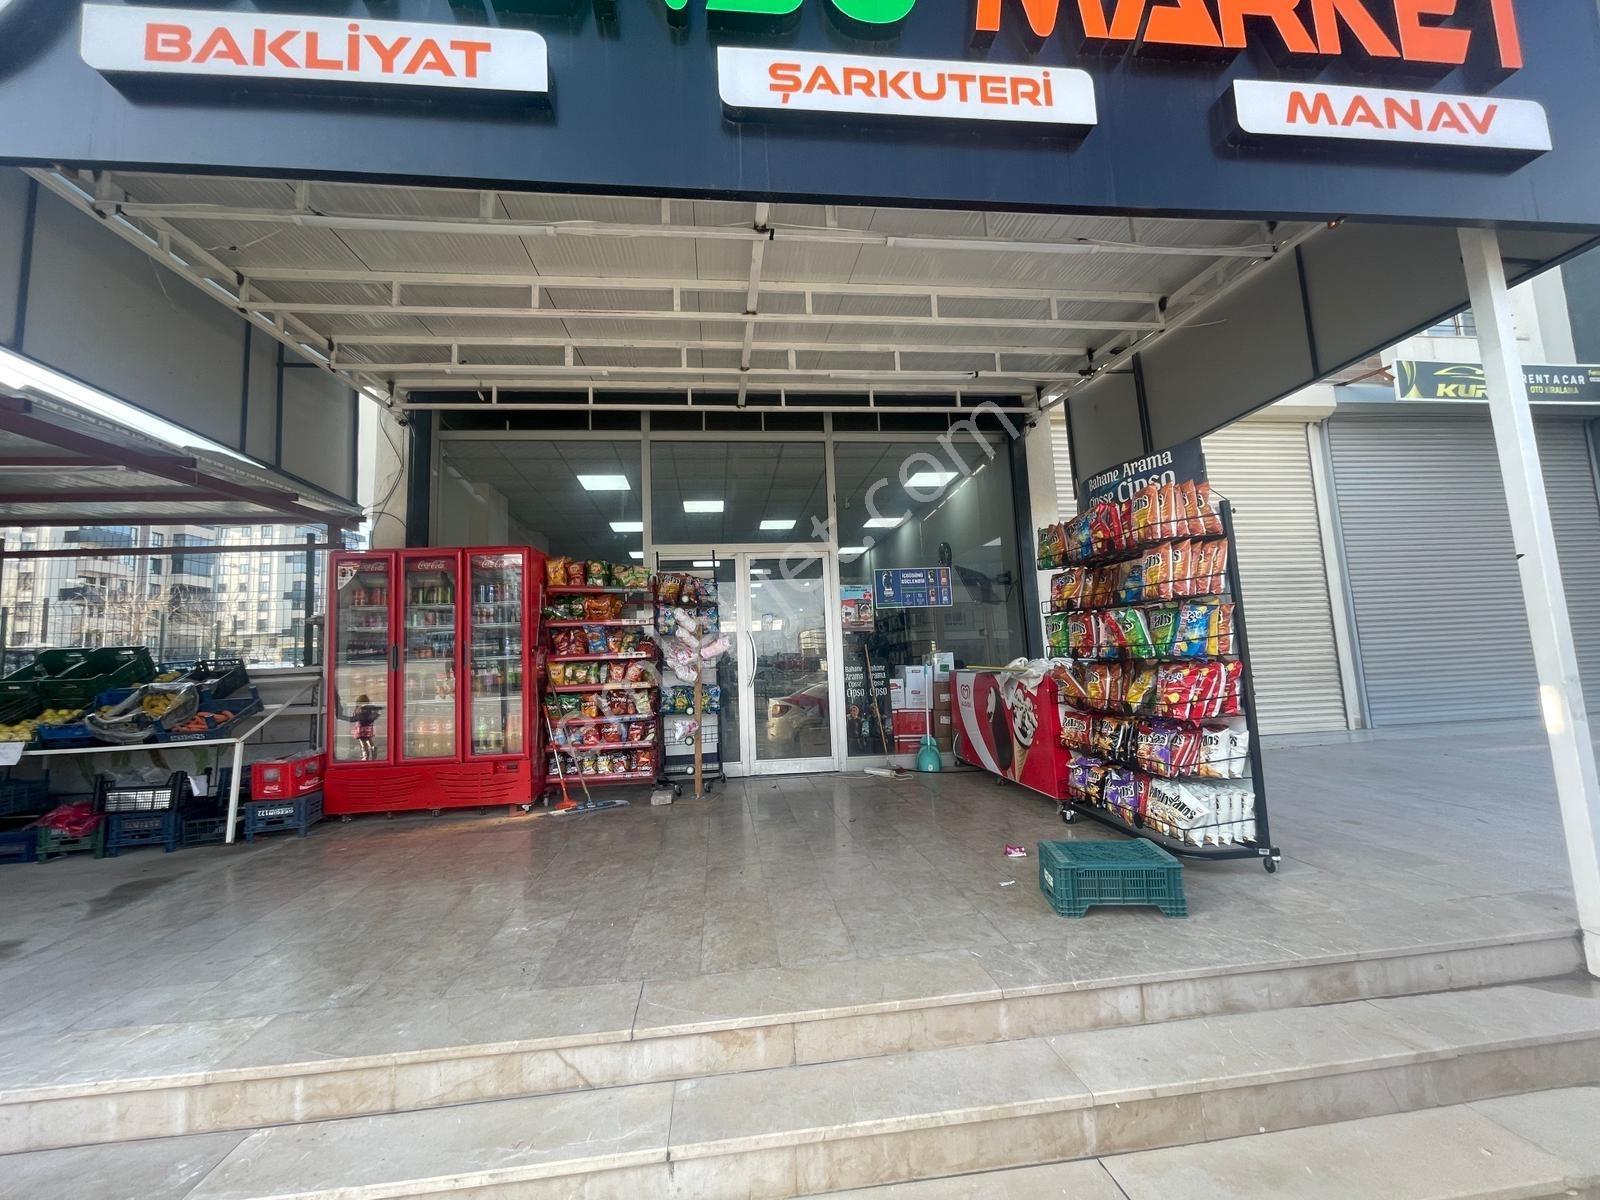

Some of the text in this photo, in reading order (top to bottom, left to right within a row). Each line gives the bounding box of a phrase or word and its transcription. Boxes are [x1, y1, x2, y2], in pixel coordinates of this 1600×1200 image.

[144, 23, 491, 78] BAKLİYAT
[768, 62, 1054, 107] ŞARKUTERİ
[1286, 90, 1498, 135] MANAV
[1553, 374, 1560, 384] A
[1561, 374, 1585, 385] CAR
[1088, 450, 1173, 492] Bahane Arama
